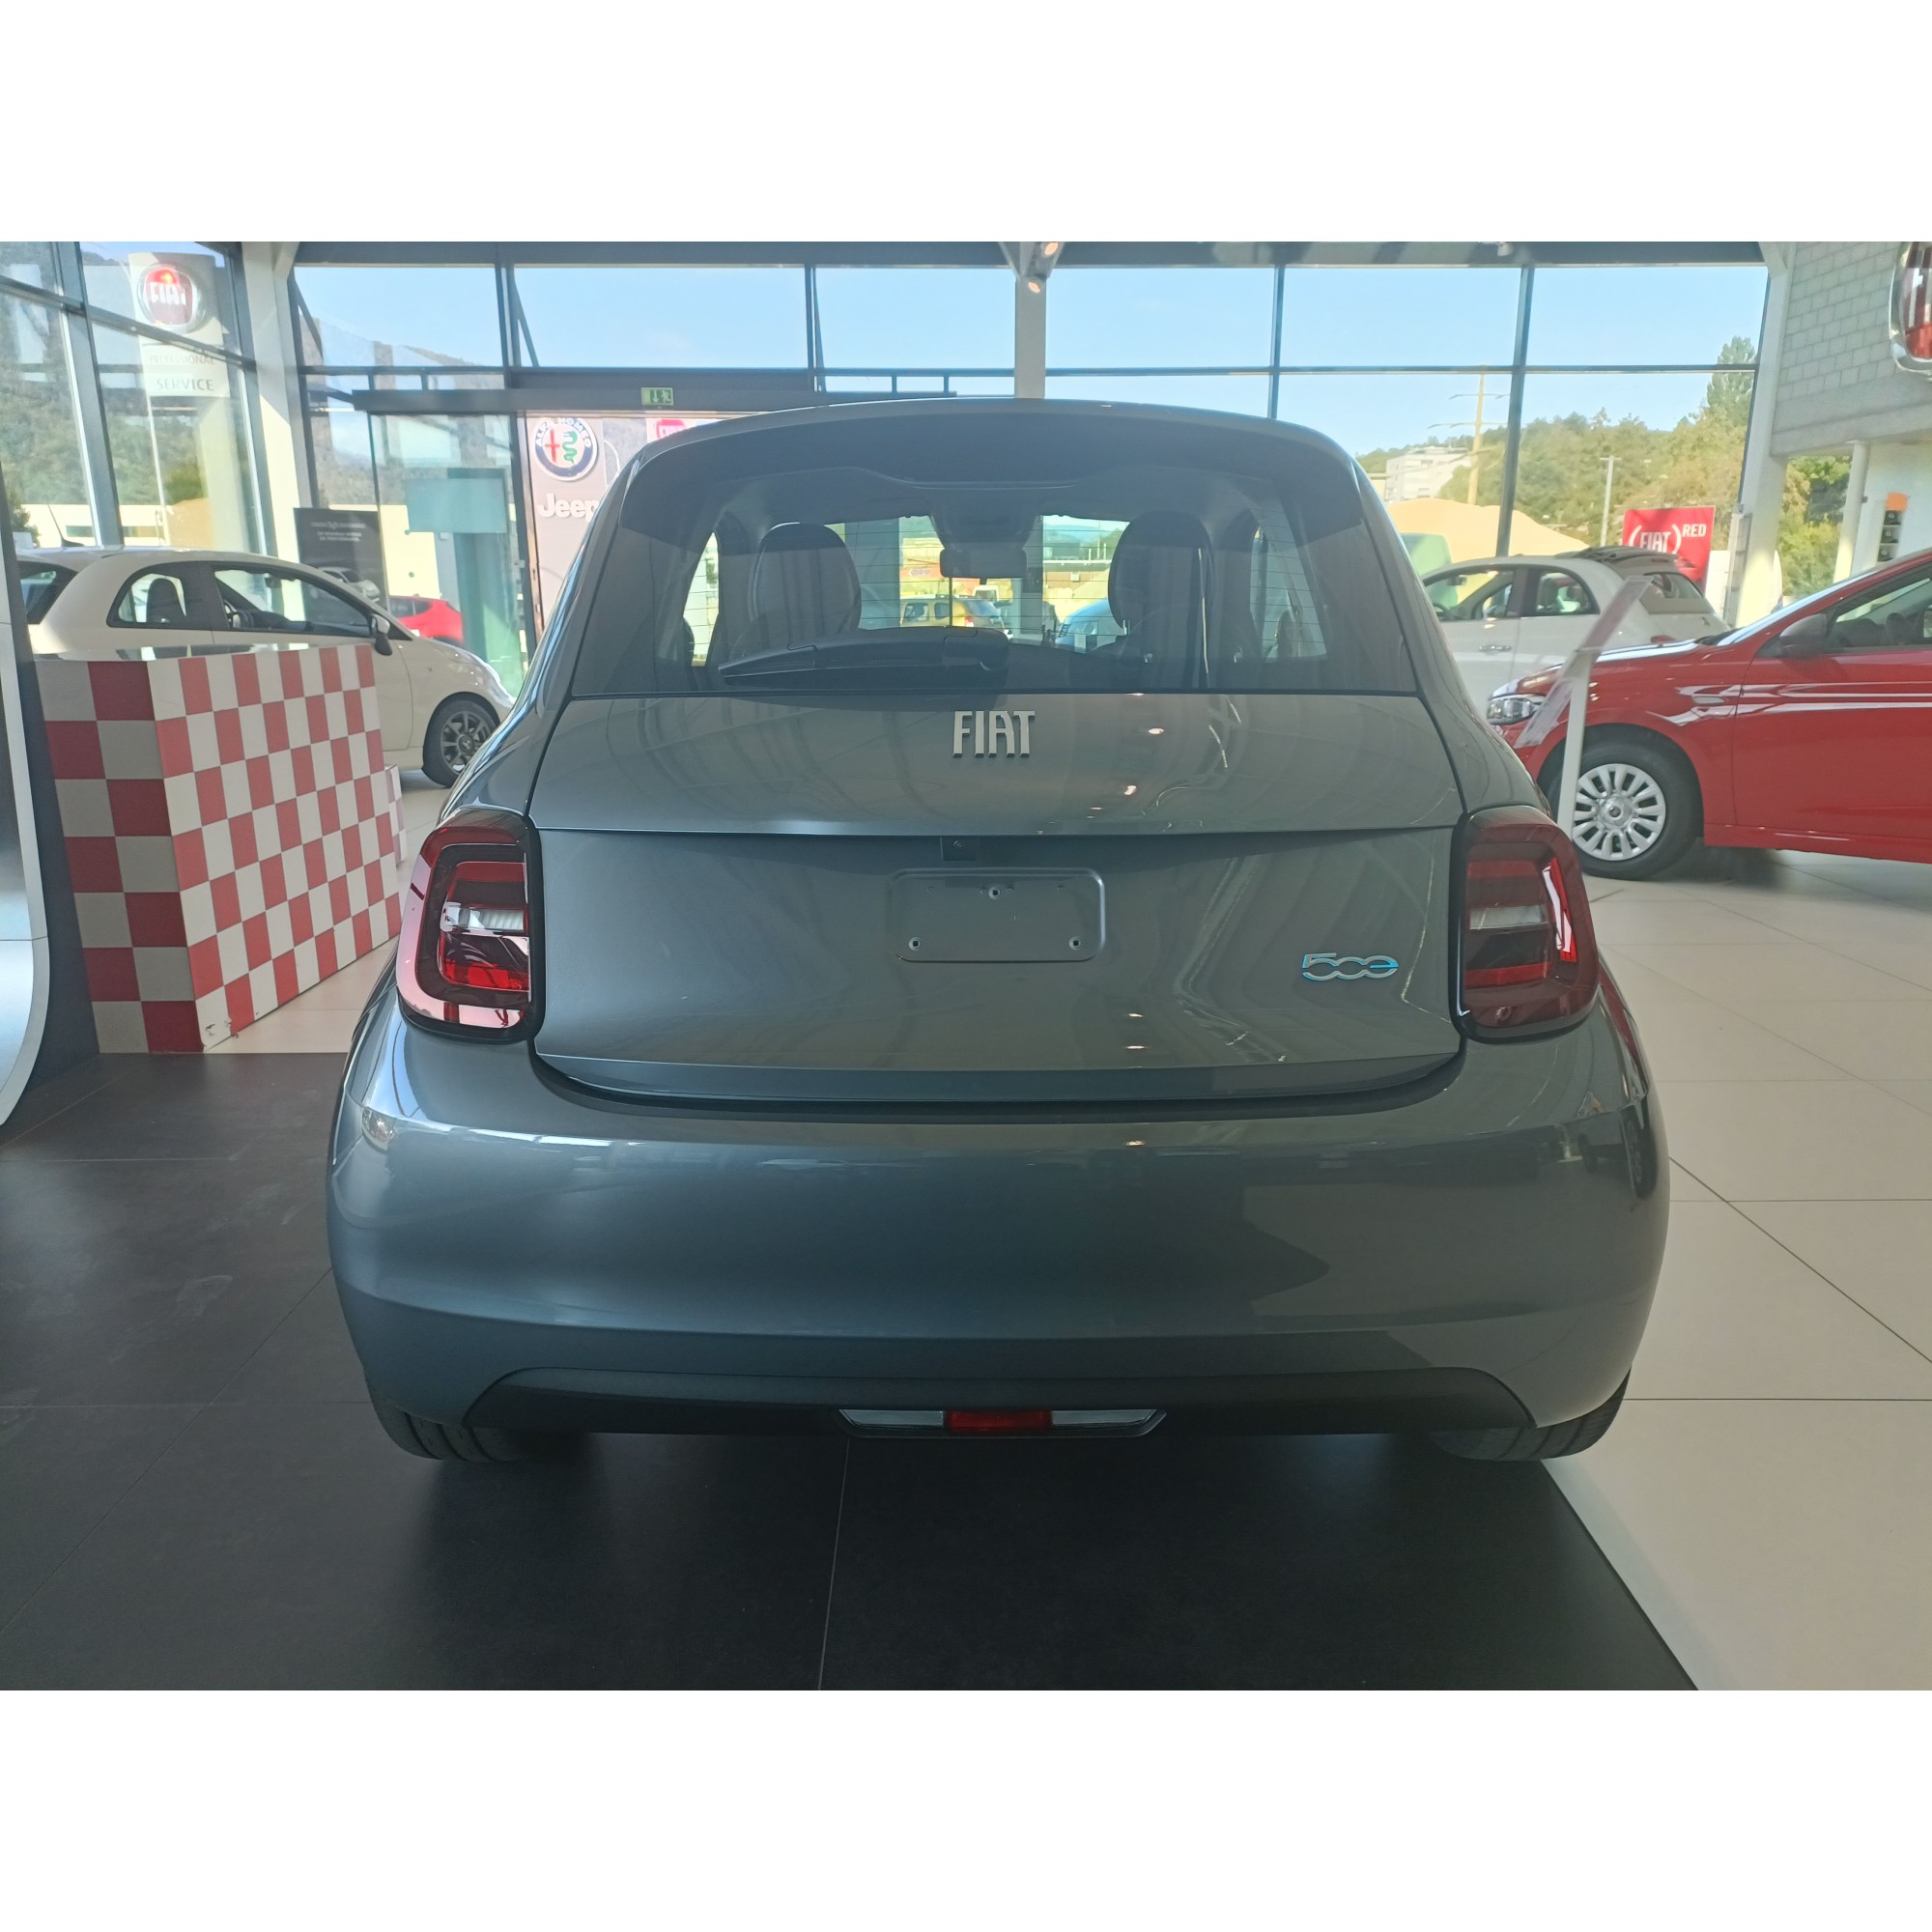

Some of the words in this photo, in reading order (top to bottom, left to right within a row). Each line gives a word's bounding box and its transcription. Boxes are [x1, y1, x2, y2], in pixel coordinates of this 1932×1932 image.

[150, 355, 215, 365] PROFESSIONAL
[156, 378, 214, 391] SERVICE
[537, 493, 599, 523] Jeep
[1682, 524, 1707, 537] RED
[953, 710, 1036, 757] FIAT
